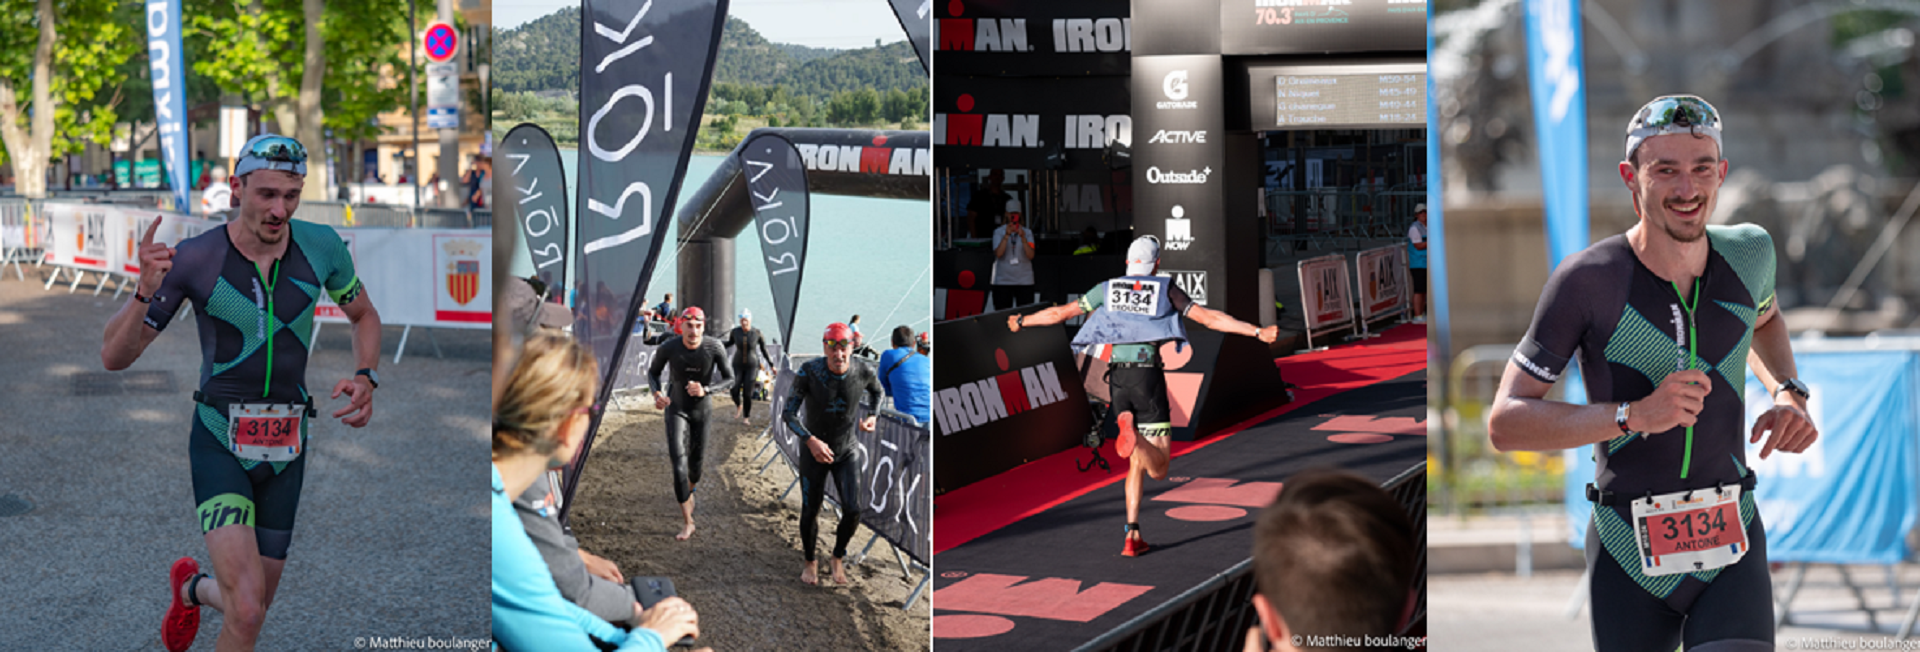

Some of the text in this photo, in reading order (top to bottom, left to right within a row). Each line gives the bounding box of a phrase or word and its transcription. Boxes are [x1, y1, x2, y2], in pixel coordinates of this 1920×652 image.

[1256, 7, 1292, 25] 70.3
[933, 0, 1028, 52] MAN
[1156, 101, 1198, 109] GATORADE
[1289, 114, 1326, 123] Trouche
[1148, 130, 1207, 143] ACTIVE
[1164, 242, 1191, 250] NOW
[1176, 273, 1205, 295] AIX
[1111, 290, 1152, 306] 3134
[1111, 304, 1150, 314] TROUCHE
[933, 347, 1068, 436] IRONMAN
[246, 419, 292, 437] 3134
[1661, 508, 1727, 540] 3134
[1675, 535, 1721, 551] ANTOINE
